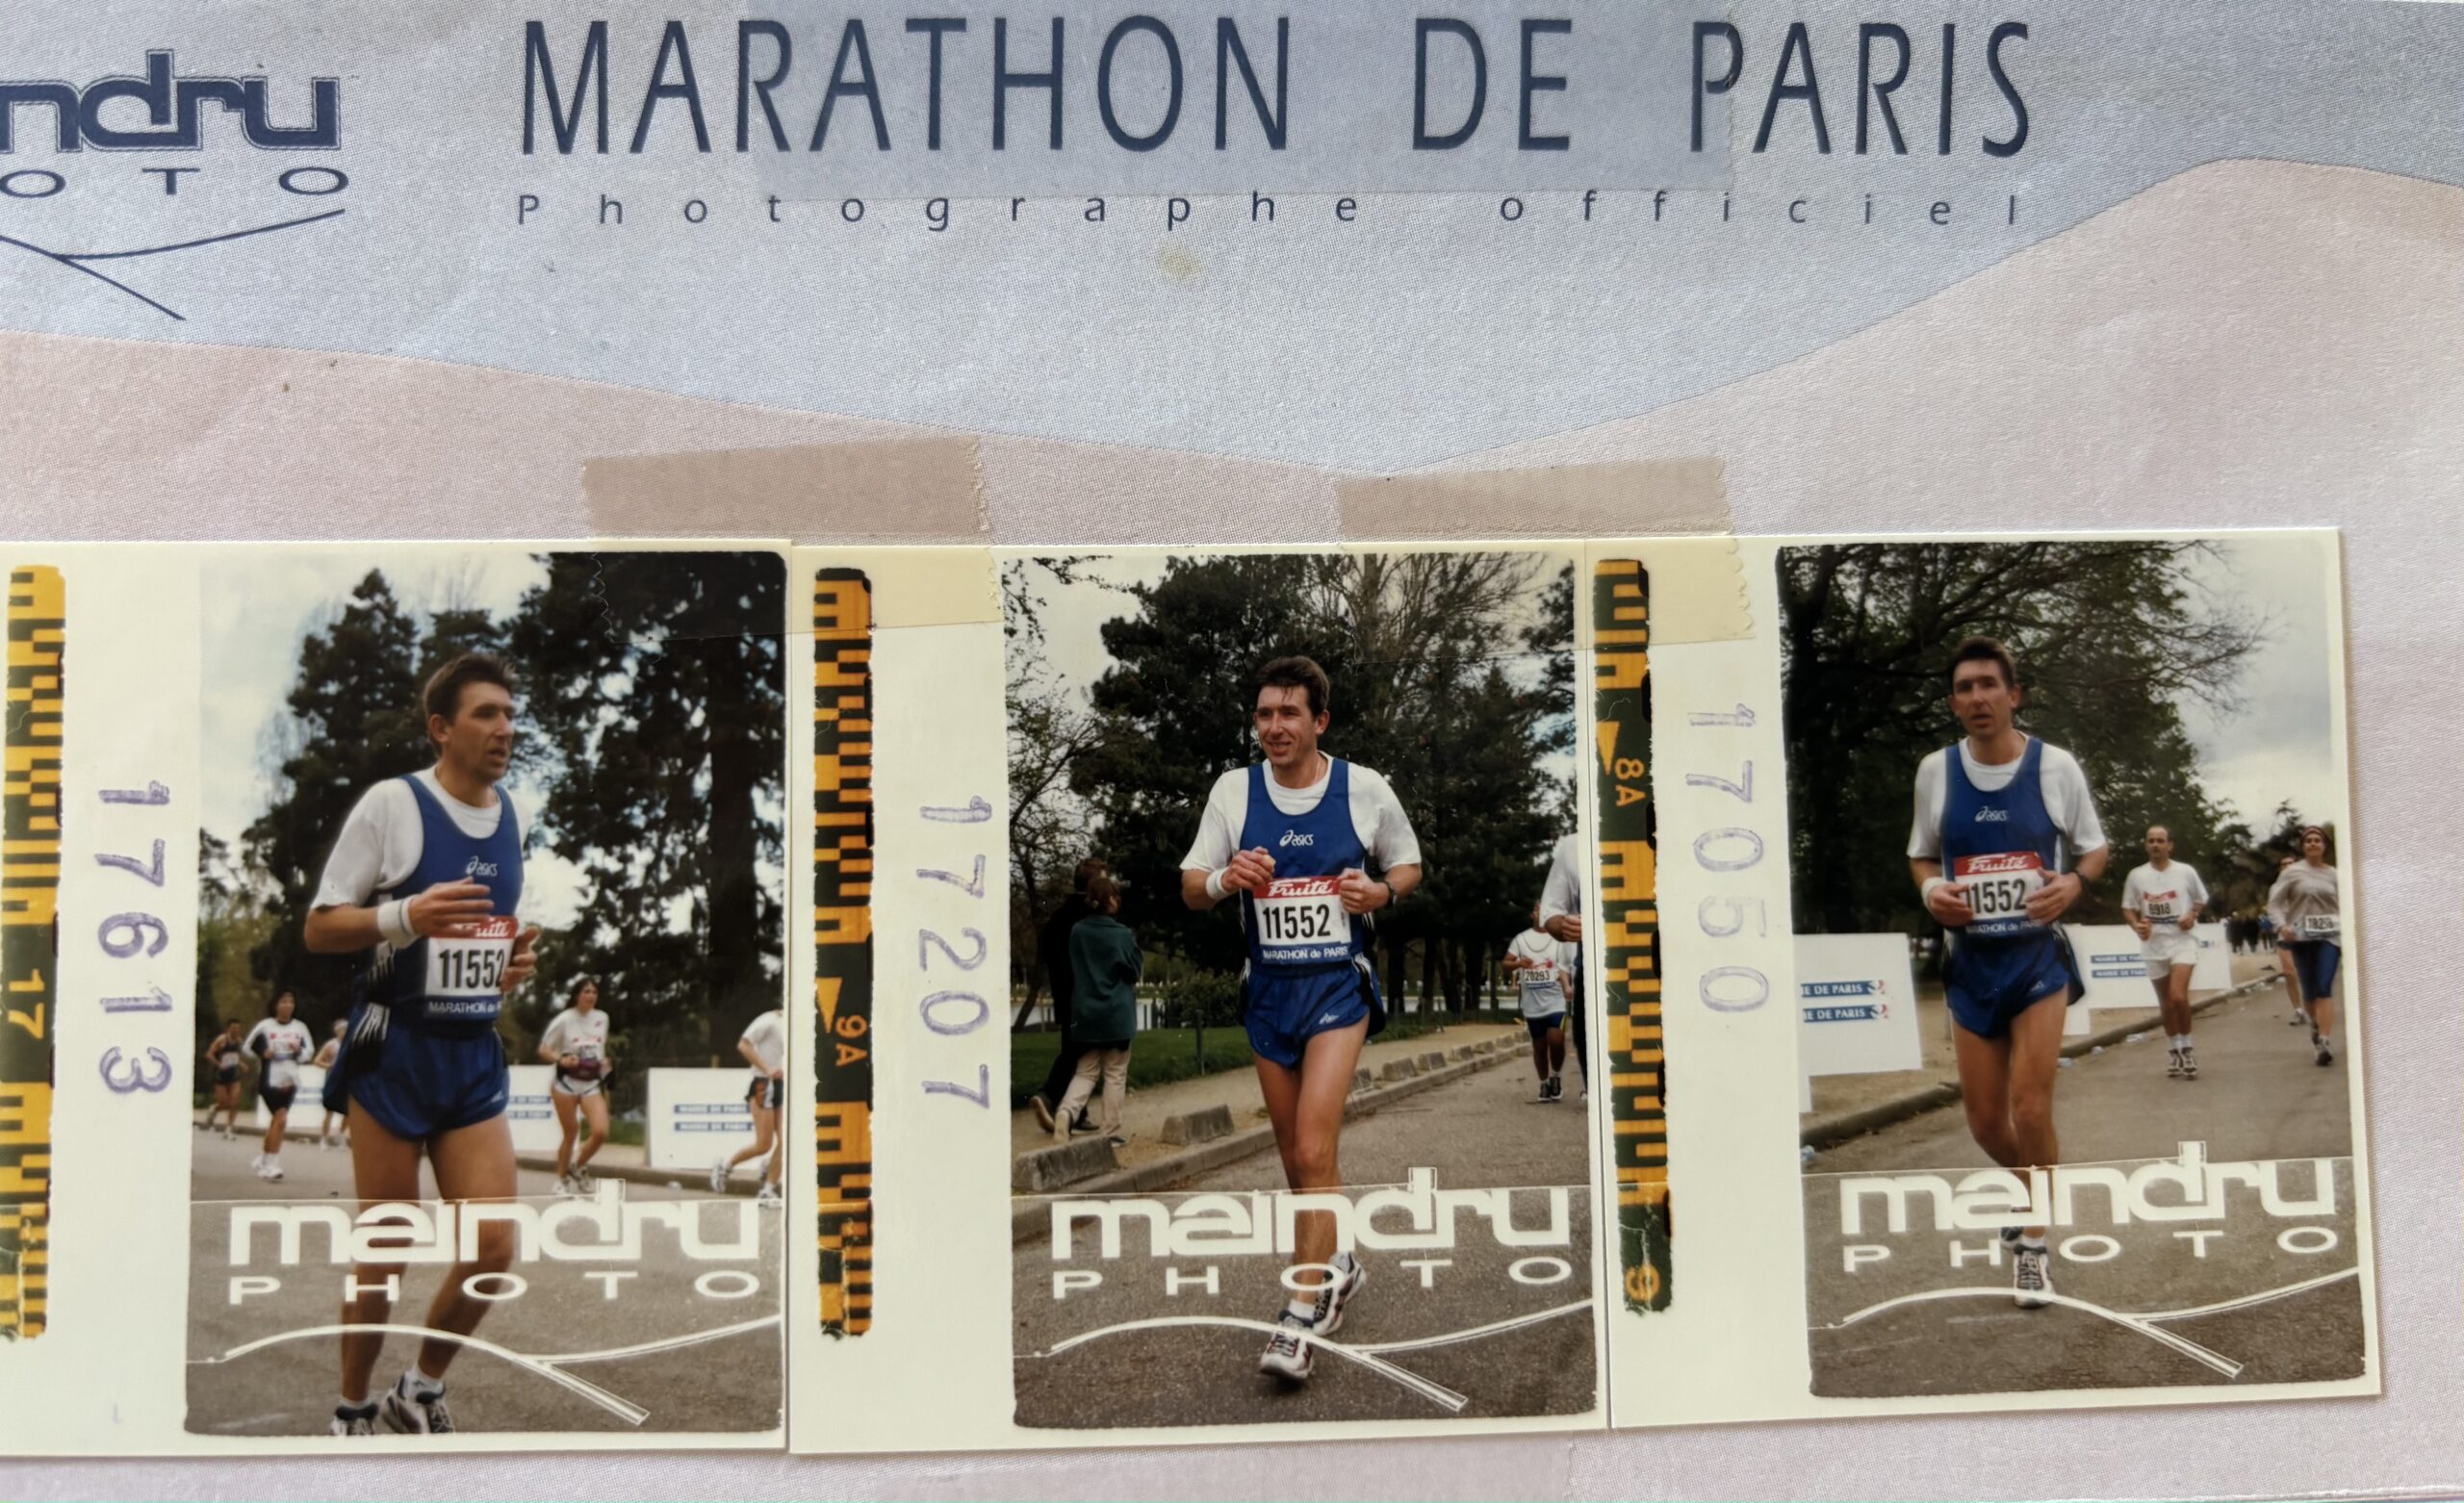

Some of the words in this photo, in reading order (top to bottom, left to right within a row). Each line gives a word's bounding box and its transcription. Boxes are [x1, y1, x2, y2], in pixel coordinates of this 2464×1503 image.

[522, 13, 1290, 155] MARATHON
[1411, 16, 1573, 151] DE
[1689, 20, 2030, 158] PARIS
[518, 191, 1358, 232] Photographe
[1500, 189, 2016, 226] officiel
[1613, 757, 1646, 806] 8A
[1685, 703, 1769, 1012] 17050
[94, 780, 172, 1093] 17613
[1262, 904, 1331, 939] 11552
[439, 949, 504, 989] 11552
[916, 796, 992, 1108] 17207
[1310, 948, 1322, 958] de
[1323, 946, 1348, 957] PARIS
[8, 968, 45, 1040] 17
[1814, 984, 1830, 995] DE
[1832, 983, 1863, 994] PARIS
[1817, 1009, 1833, 1020] DE
[1835, 1008, 1866, 1019] PARIS
[834, 1014, 868, 1067] 9A
[1839, 1140, 2336, 1235] maindru
[229, 1178, 760, 1265] maindru
[1051, 1166, 1572, 1260] maindru
[1842, 1225, 2339, 1273] PHOTO
[229, 1270, 760, 1306] PHOTO
[1052, 1256, 1573, 1299] PHOTO
